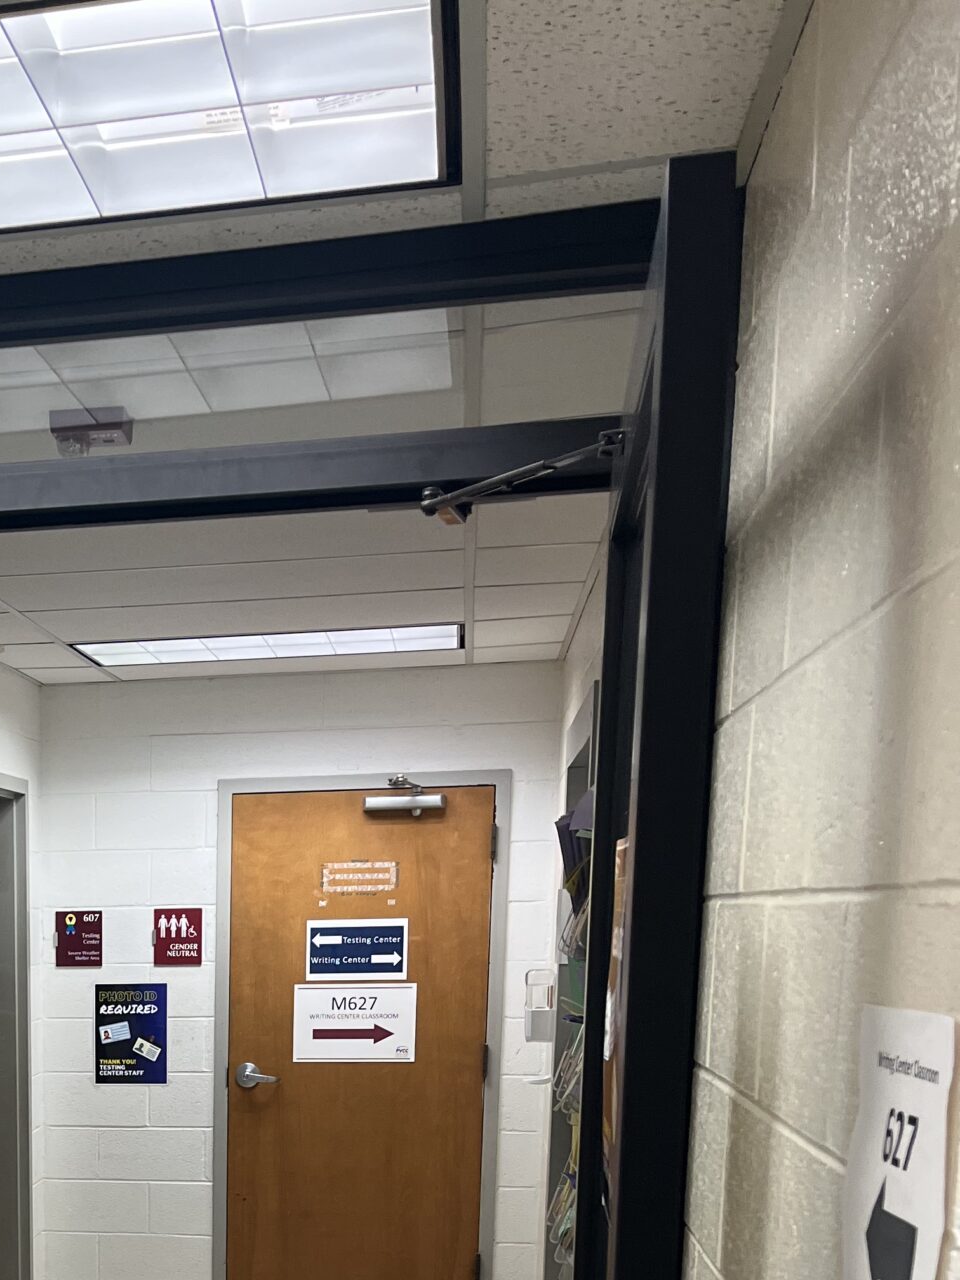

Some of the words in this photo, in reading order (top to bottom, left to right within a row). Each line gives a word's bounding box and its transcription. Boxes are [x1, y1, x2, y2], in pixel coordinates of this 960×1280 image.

[83, 914, 100, 922] 607
[342, 935, 371, 944] Testing
[373, 935, 401, 944] Center
[310, 955, 340, 965] Writing
[342, 956, 369, 964] Center
[99, 990, 143, 1002] PHOTO
[144, 990, 158, 1002] ID
[331, 996, 378, 1011] M627
[99, 1004, 158, 1015] REQUIRED
[878, 1050, 896, 1075] Writing
[895, 1055, 913, 1077] Center
[913, 1060, 940, 1085] Classroom
[882, 1107, 920, 1171] 627
